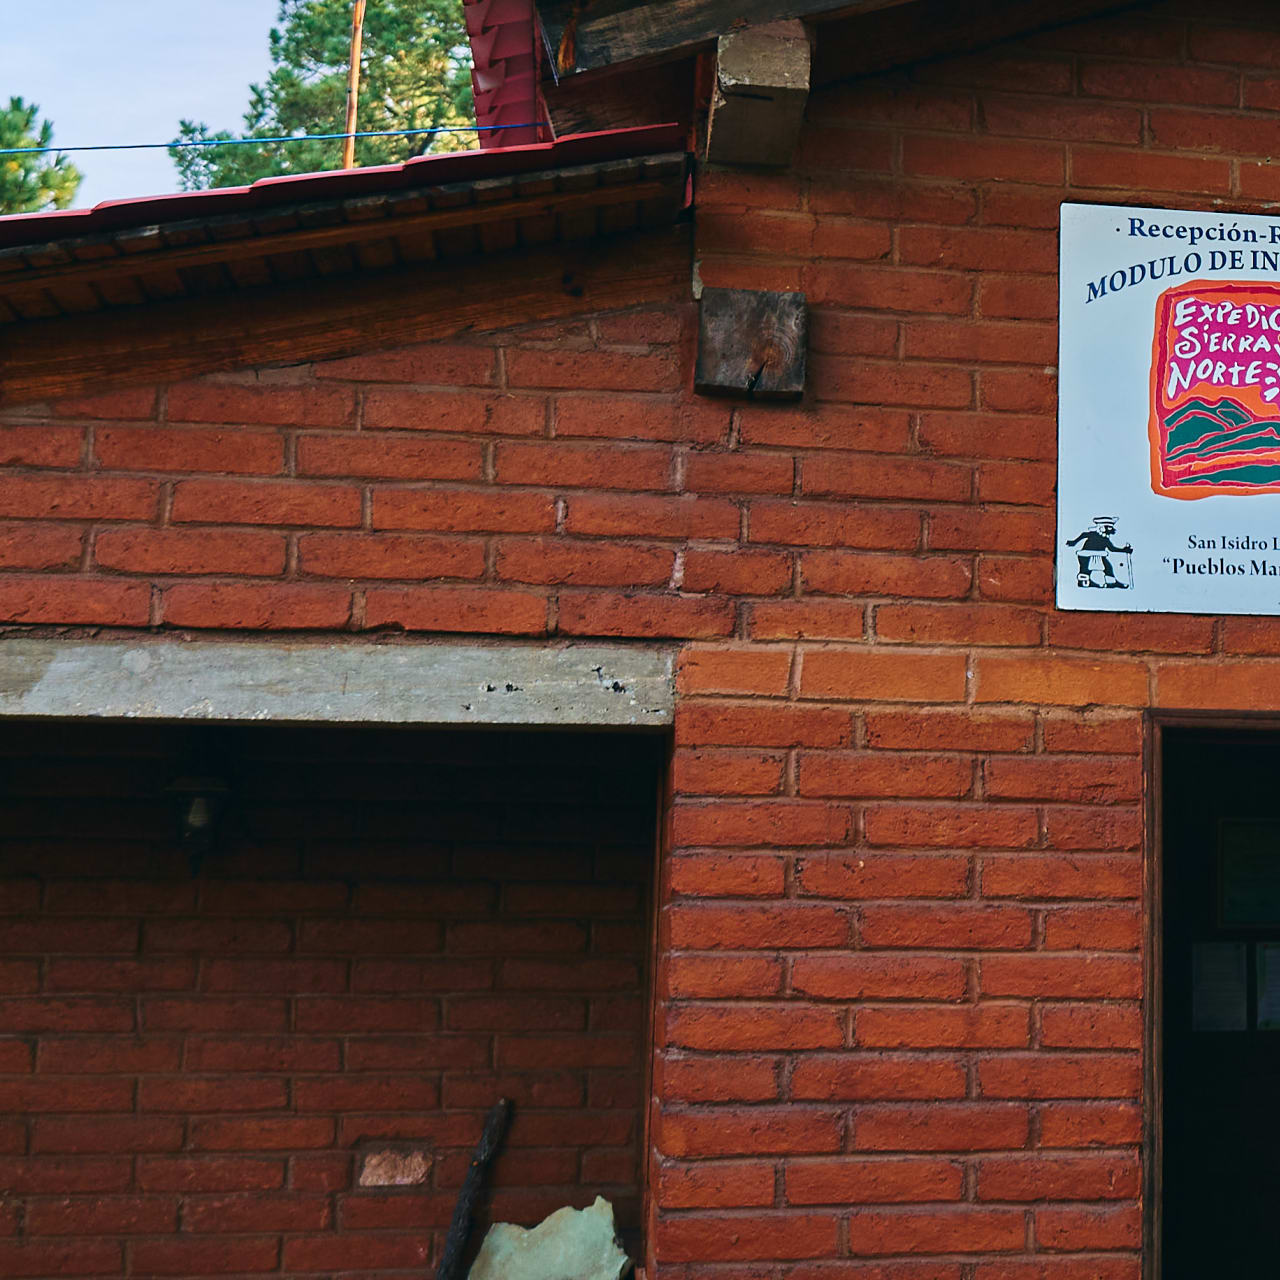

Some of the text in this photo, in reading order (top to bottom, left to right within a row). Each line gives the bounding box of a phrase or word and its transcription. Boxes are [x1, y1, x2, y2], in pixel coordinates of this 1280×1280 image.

[1085, 251, 1202, 304] MODULO
[1208, 250, 1244, 271] DE
[1167, 358, 1263, 399] NORTE
[1187, 534, 1218, 551] San
[1221, 535, 1268, 552] Isidro
[1162, 557, 1246, 577] “Pueblos
